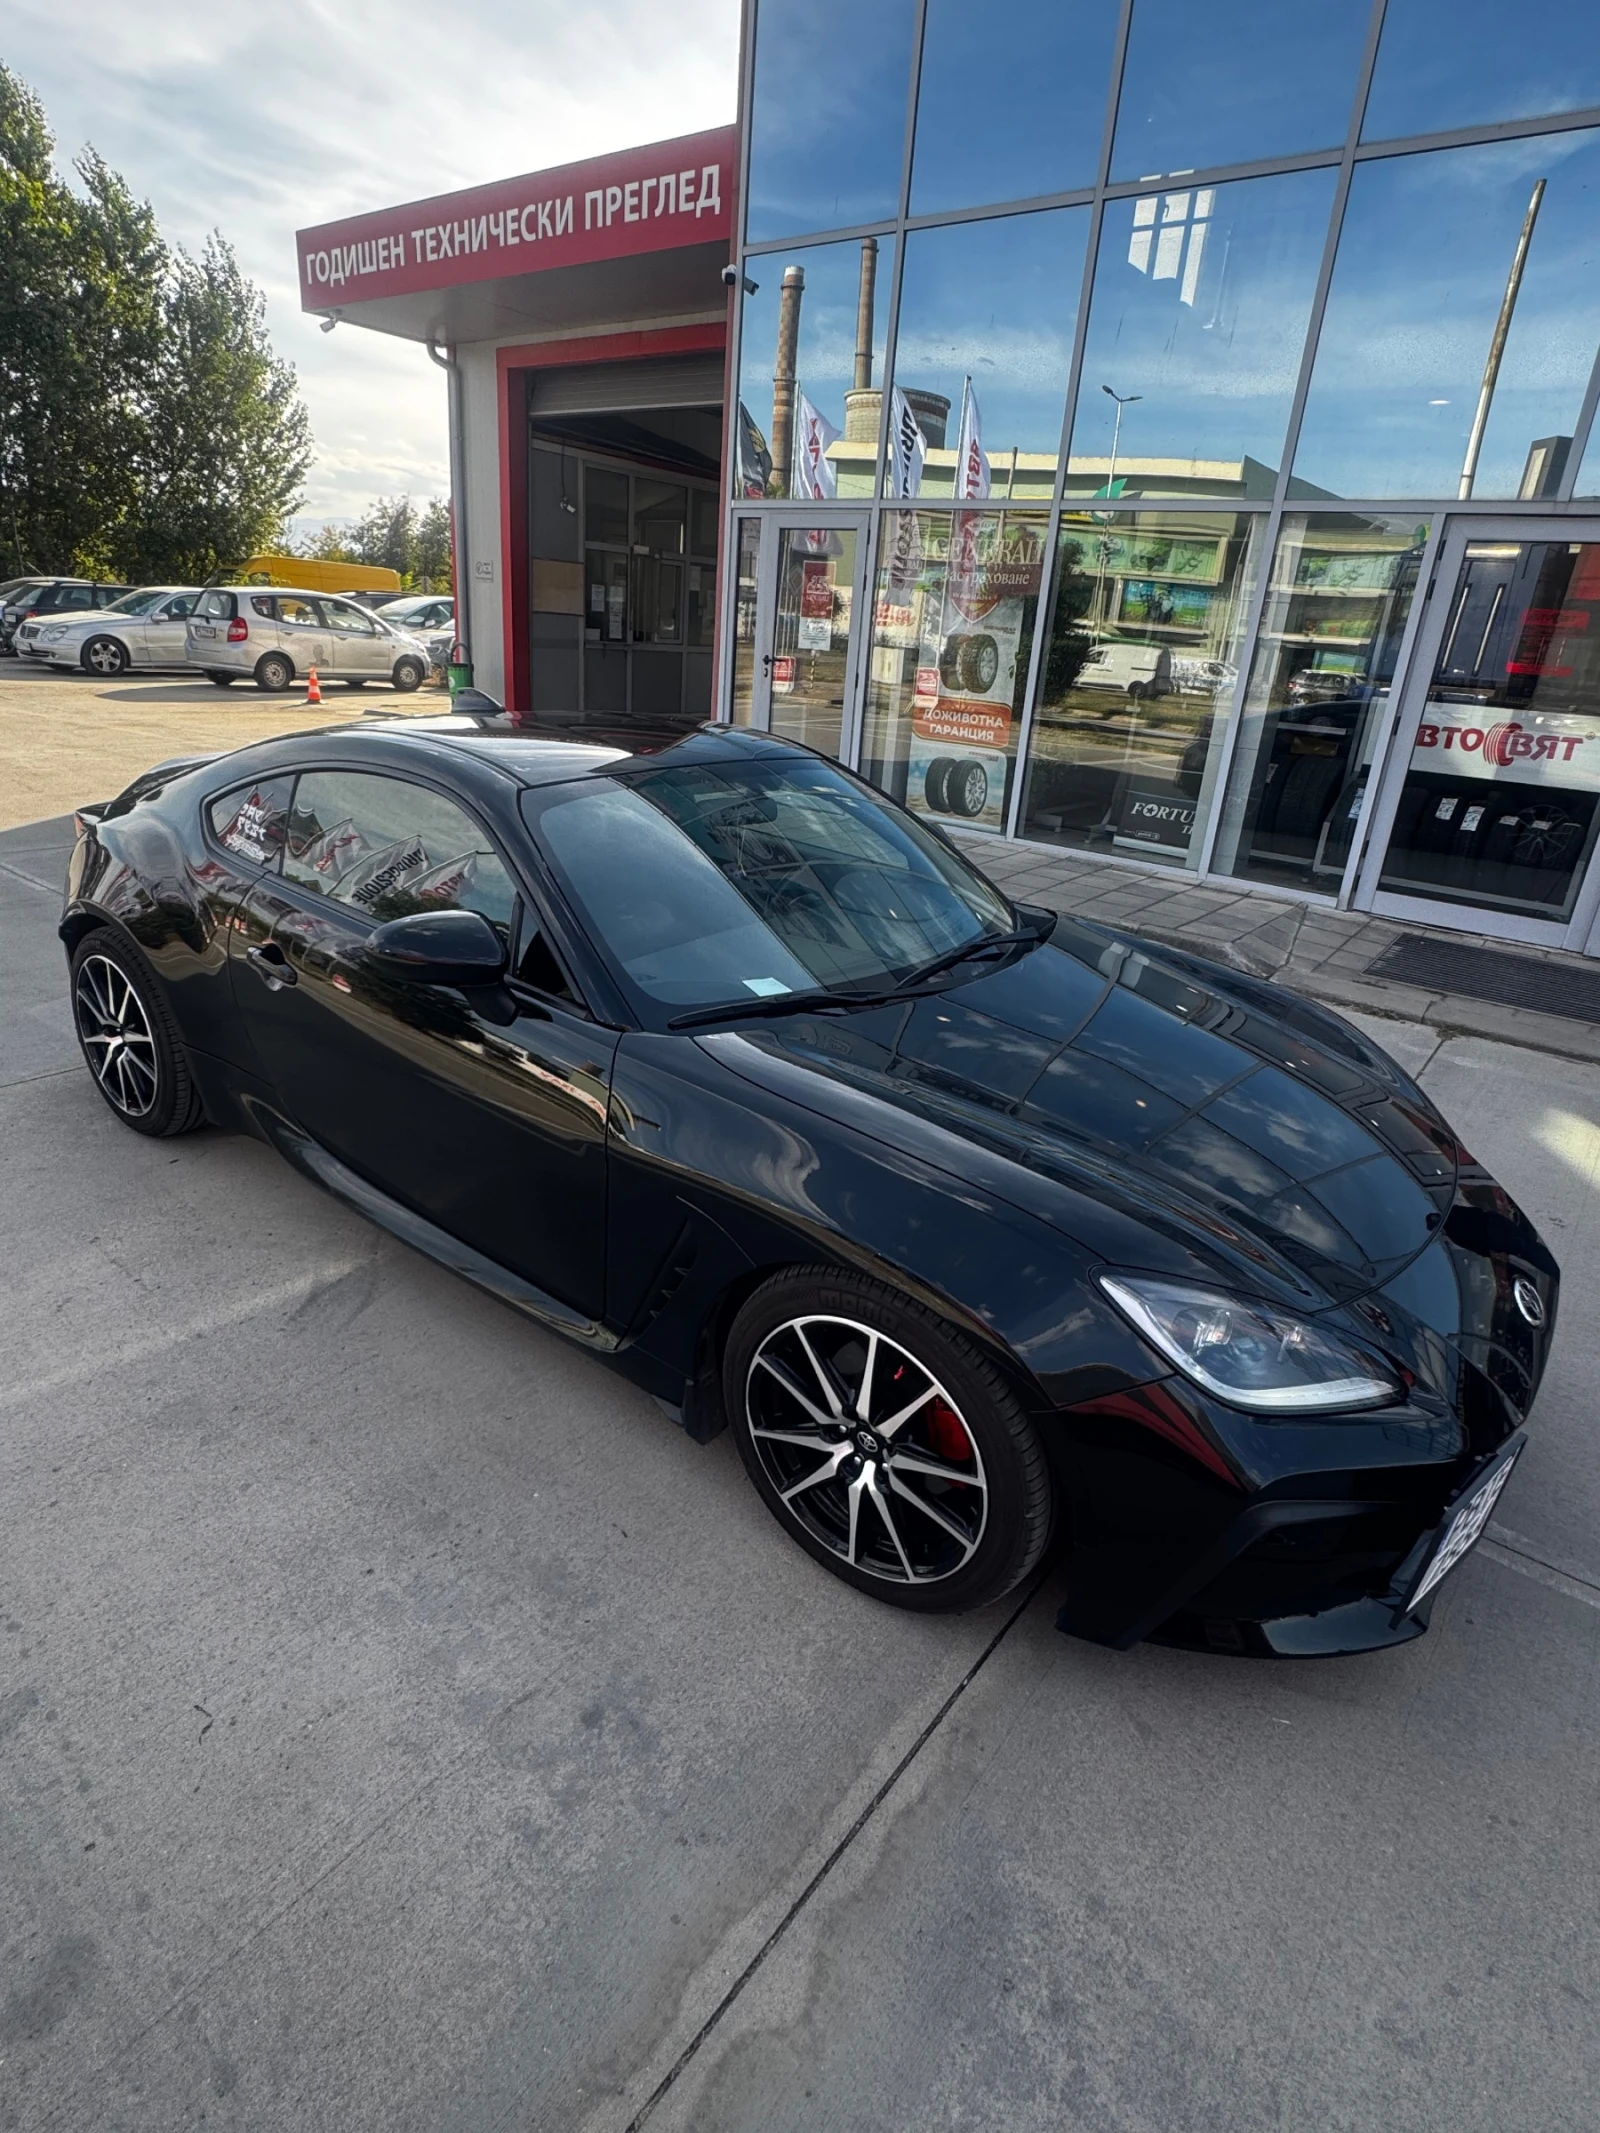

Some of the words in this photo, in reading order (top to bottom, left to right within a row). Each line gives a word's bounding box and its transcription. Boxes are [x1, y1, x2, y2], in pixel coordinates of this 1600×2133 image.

[306, 233, 405, 288] ГОДИШЕН
[411, 195, 574, 264] ТЕХНИЧЕСКИ
[584, 164, 721, 231] ПРЕГЛЕД
[923, 708, 1004, 728] ДОЖИВОТНА
[930, 724, 994, 741] ГАРАНЦИЯ
[1416, 722, 1584, 766] ВТОСВЯТ
[1131, 802, 1195, 824] FORTU
